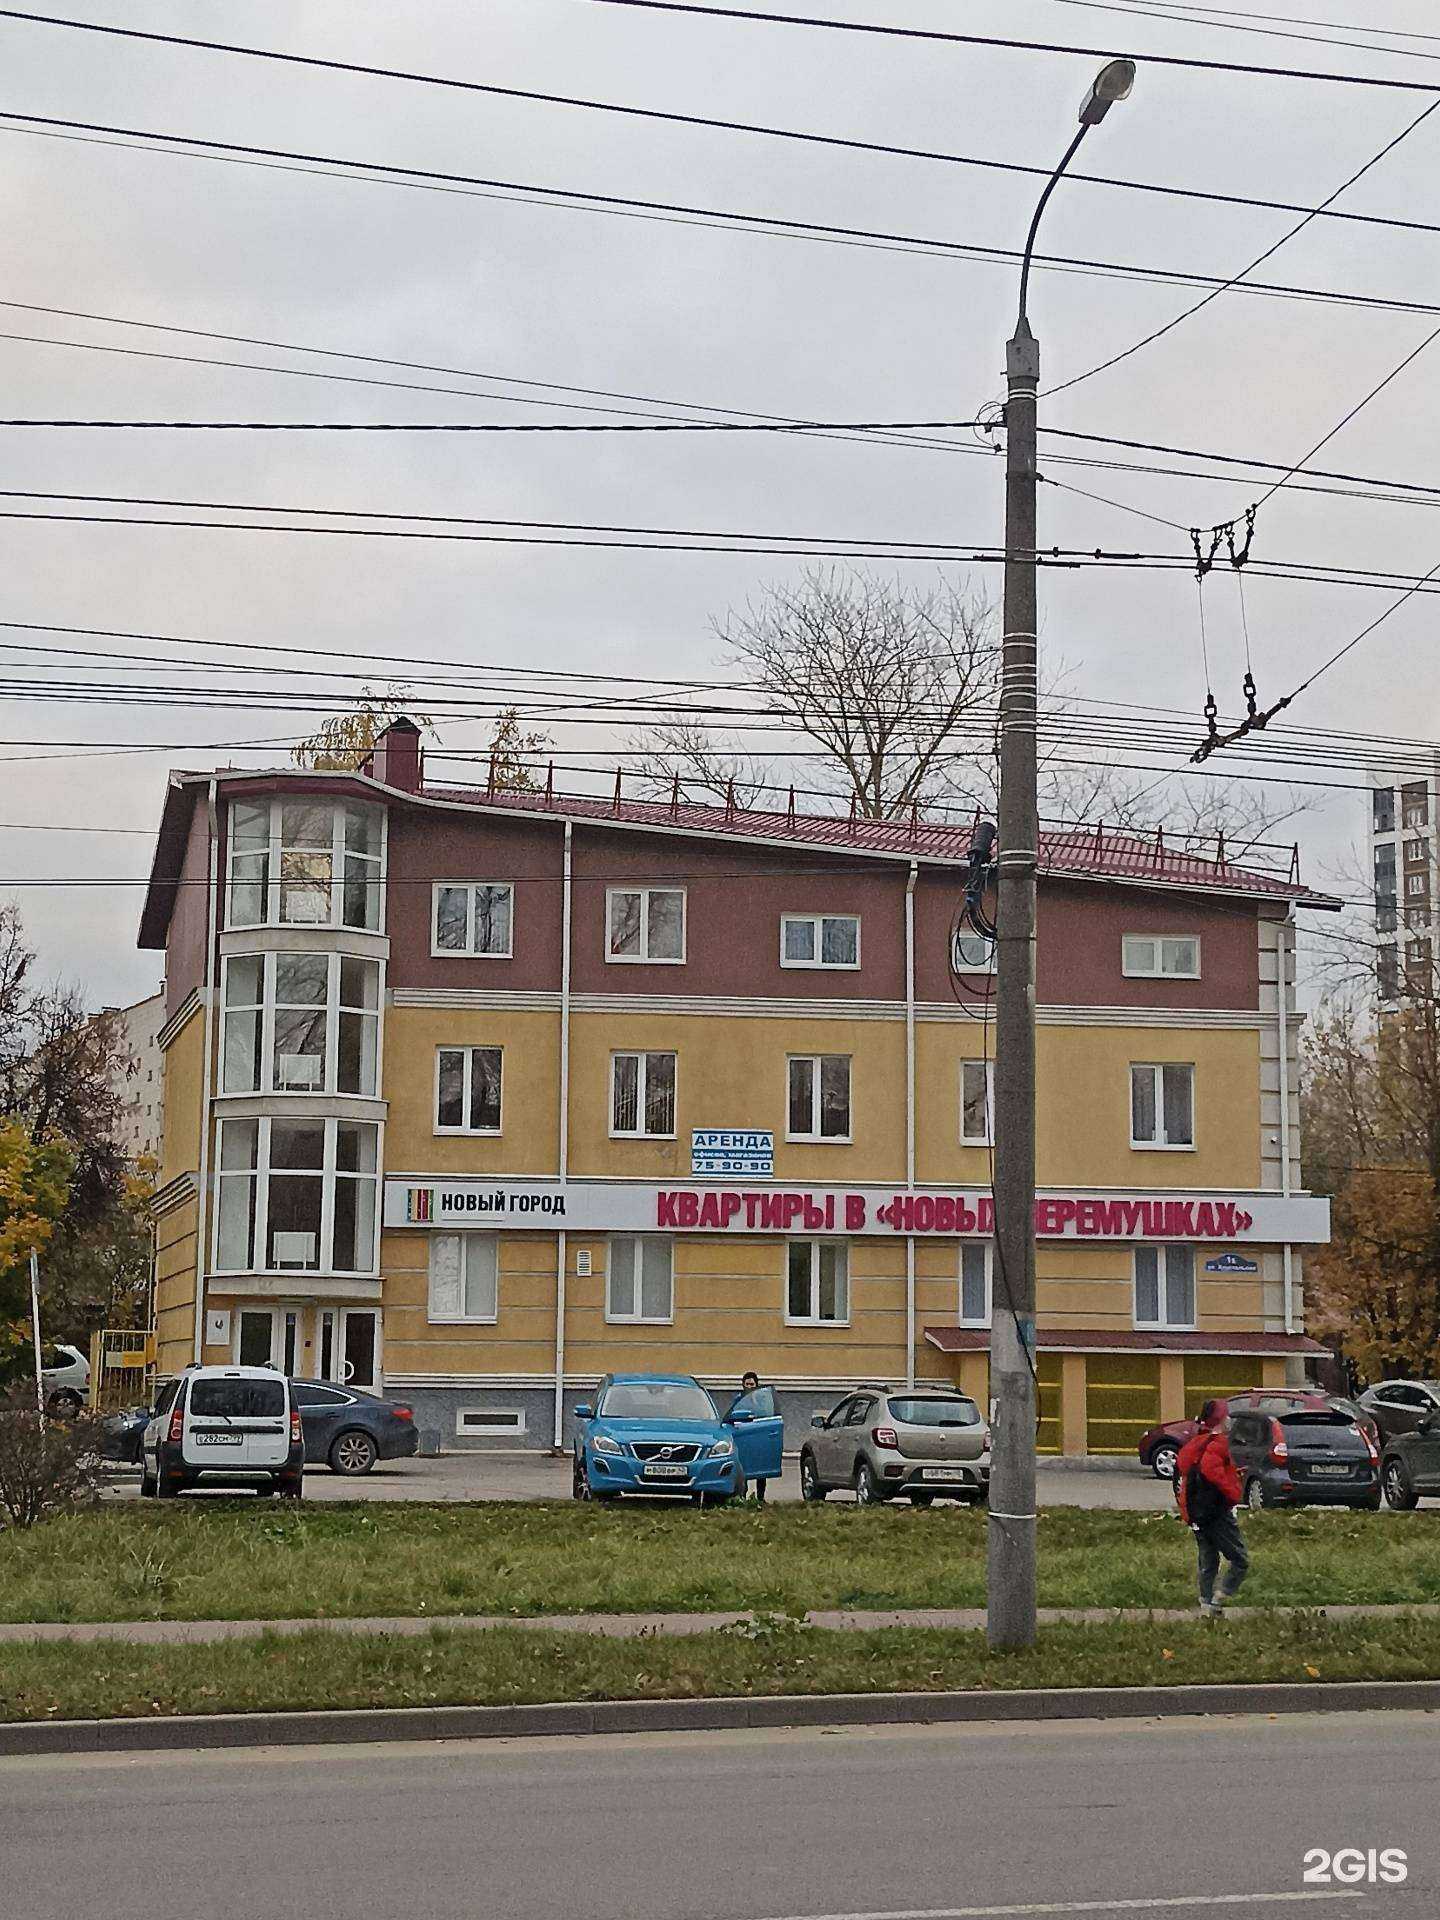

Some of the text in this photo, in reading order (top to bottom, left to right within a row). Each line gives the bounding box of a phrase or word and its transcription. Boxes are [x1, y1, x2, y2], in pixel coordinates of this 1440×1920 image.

[695, 1135, 771, 1149] АРЕНДА
[695, 1161, 771, 1170] 75-90-90
[441, 1190, 566, 1215] НОВЫЙ ГОРОД
[657, 1191, 835, 1230] КВАРТИРЫ
[845, 1195, 866, 1231] В
[1034, 1199, 1253, 1237] ЕРЕМУШКАХ»
